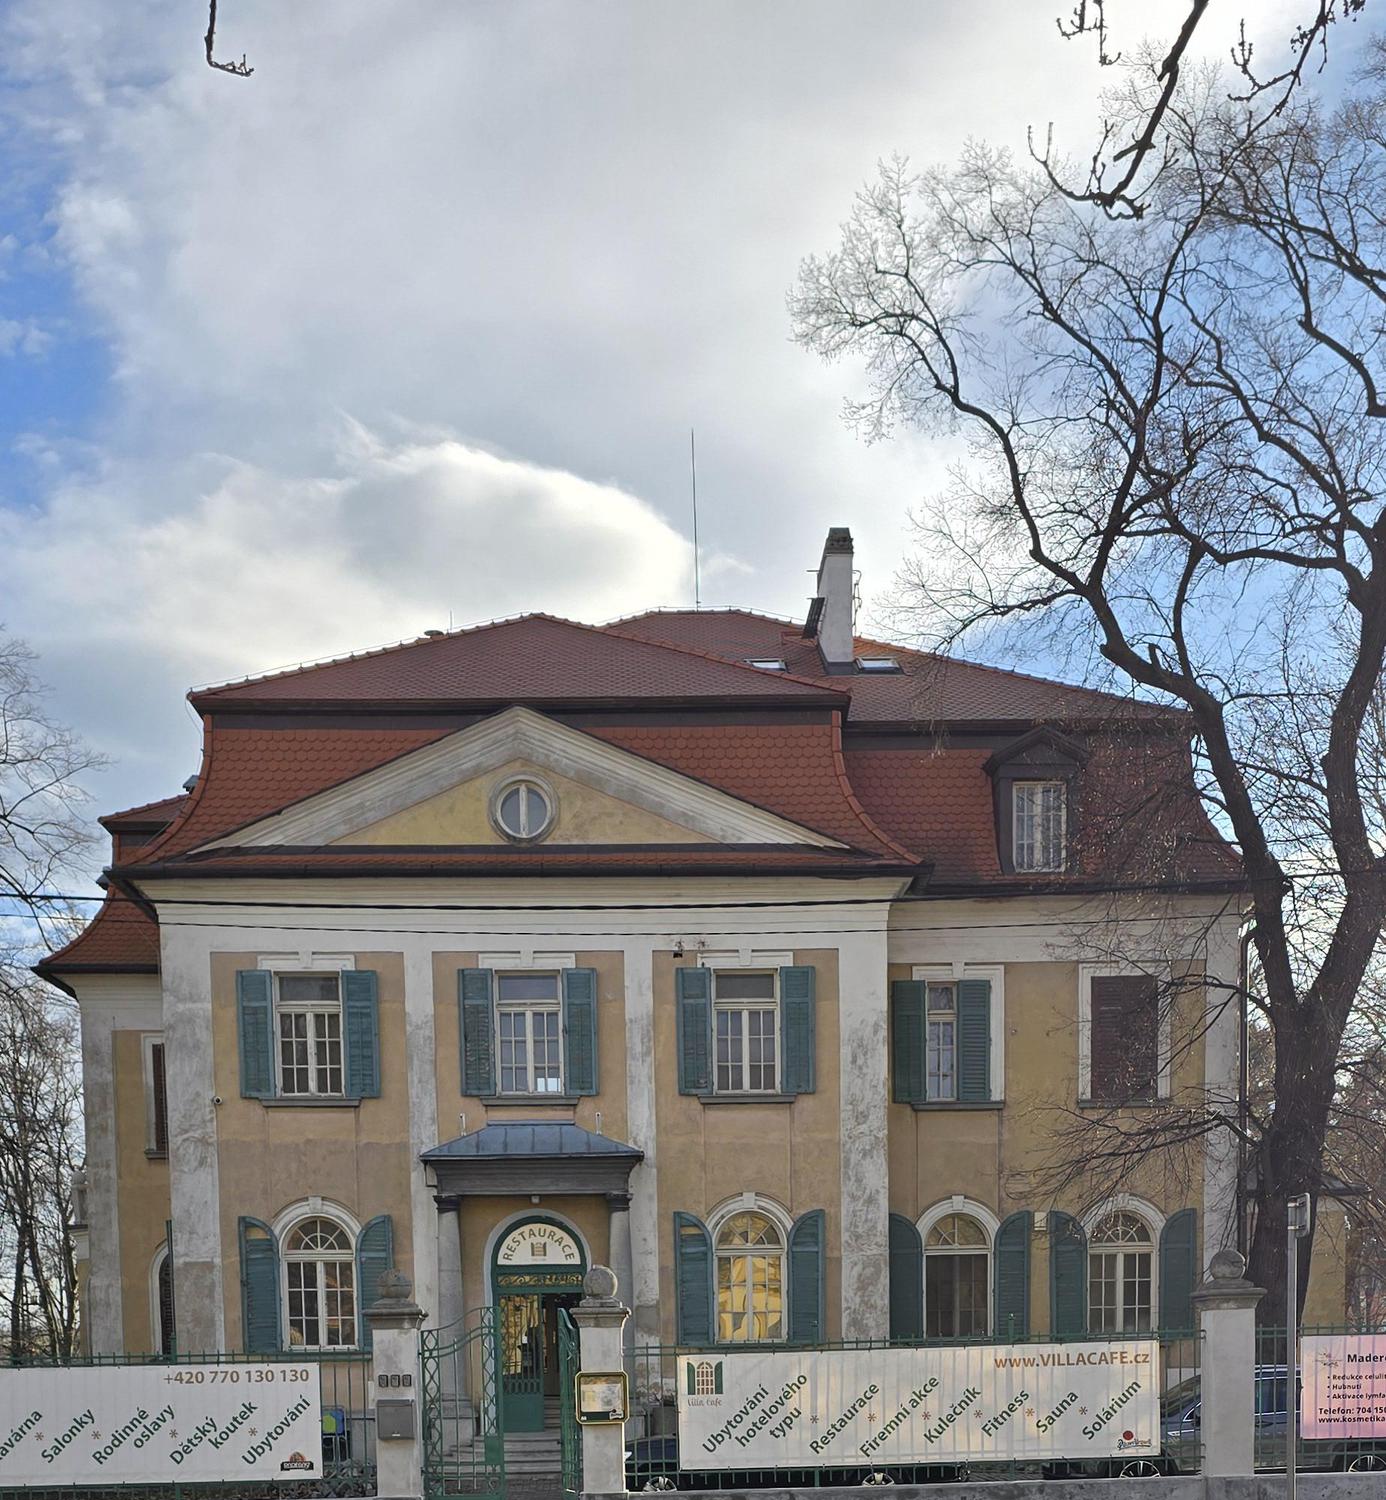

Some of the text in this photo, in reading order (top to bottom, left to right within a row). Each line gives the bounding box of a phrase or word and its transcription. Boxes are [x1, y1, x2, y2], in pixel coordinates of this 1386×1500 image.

[502, 1227, 575, 1261] RESTAURACE
[164, 1368, 309, 1385] +420 770 130 130
[994, 1352, 1150, 1369] www.VILLACAFE.cz
[1347, 1353, 1386, 1363] Mader
[133, 1402, 176, 1449] oslavy
[208, 1400, 258, 1450] koutek
[241, 1394, 312, 1465] Ubytování
[702, 1382, 770, 1456] Ubytování
[735, 1371, 808, 1448] hotelového
[769, 1405, 803, 1441] typu
[809, 1381, 881, 1456] Restaurace
[859, 1376, 940, 1458] Firemní akce
[923, 1384, 982, 1445] Kulečník
[981, 1389, 1030, 1438] Fitness
[1036, 1391, 1079, 1434] Sauna
[1083, 1380, 1142, 1441] Solárium
[1319, 1407, 1355, 1415] Telefon:
[1357, 1406, 1372, 1414] 704
[0, 1410, 43, 1461] avárna
[41, 1408, 95, 1464] Salonky
[92, 1406, 150, 1465] Rodinné
[169, 1415, 218, 1466] Dětský
